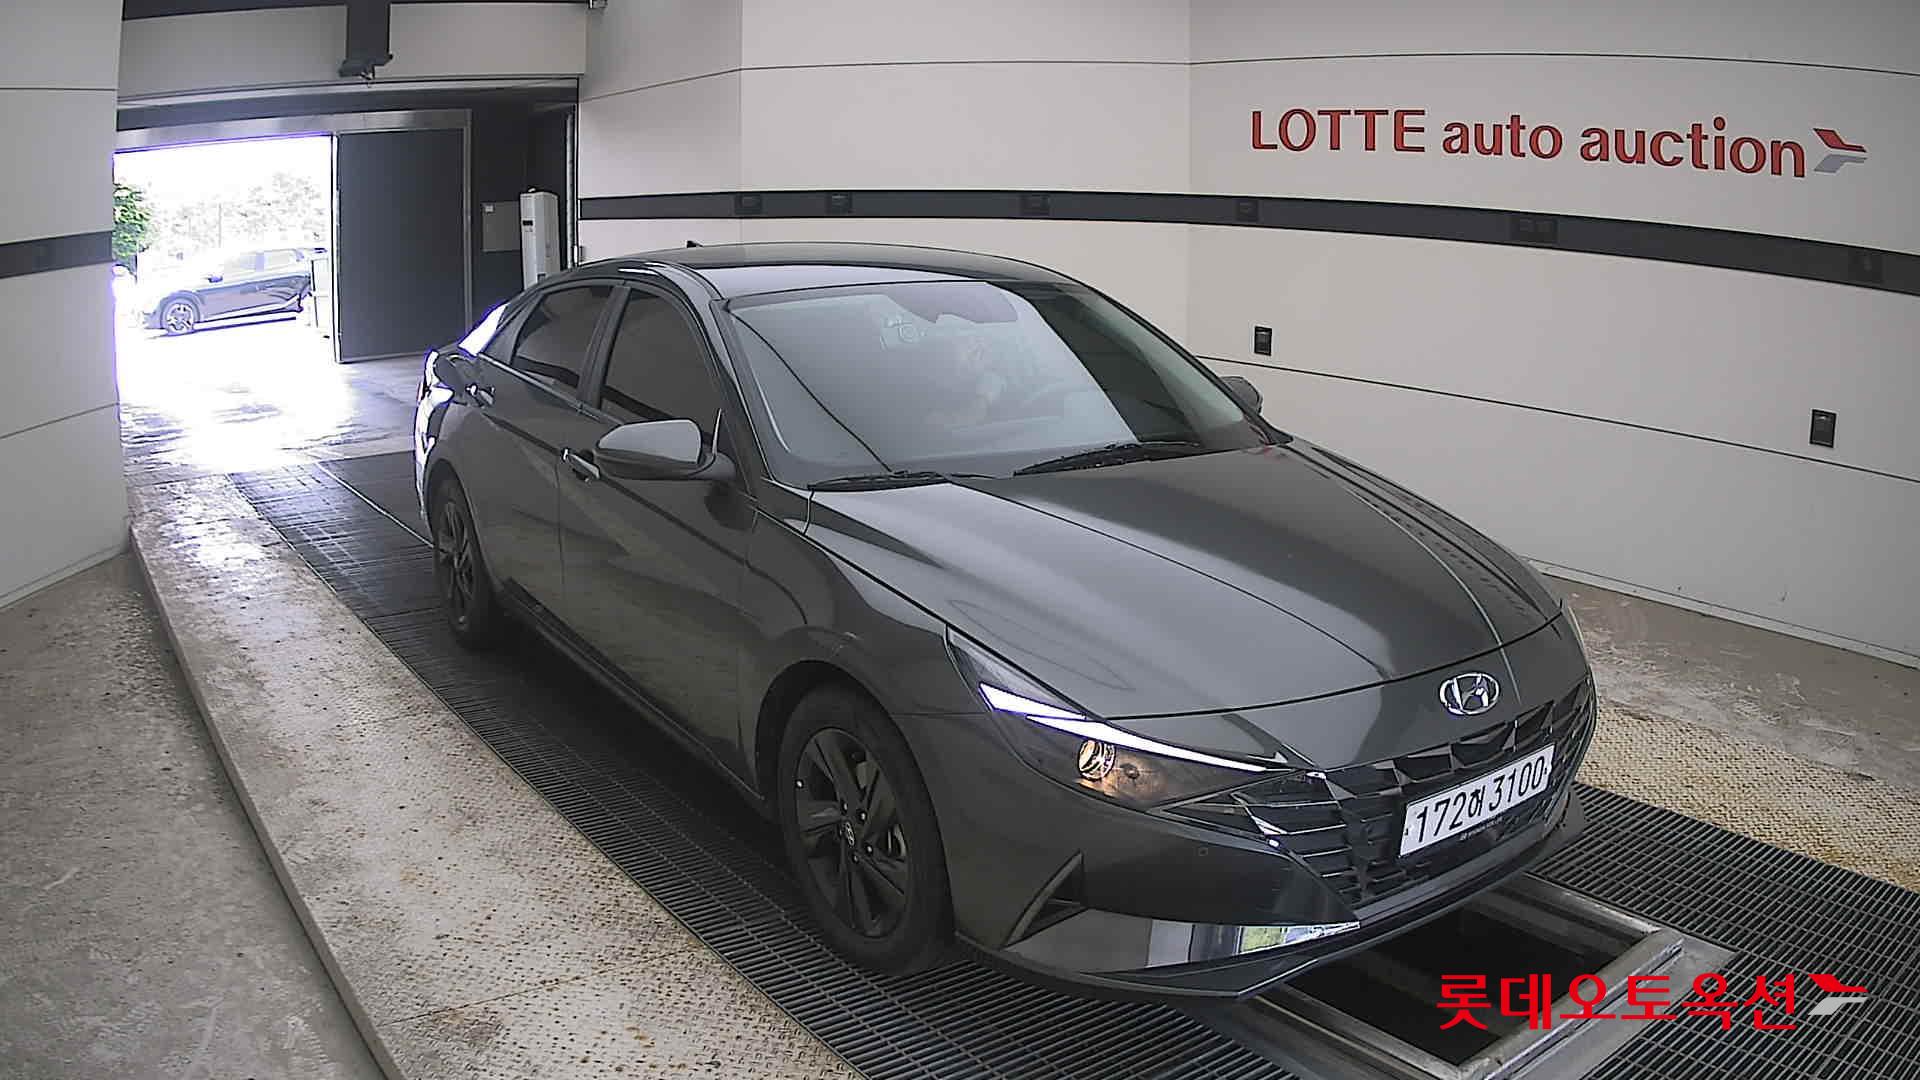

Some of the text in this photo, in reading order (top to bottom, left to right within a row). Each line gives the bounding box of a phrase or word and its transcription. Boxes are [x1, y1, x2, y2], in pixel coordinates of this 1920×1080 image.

[1251, 108, 1807, 178] LOTTE auto auction
[1489, 756, 1546, 812] 3100
